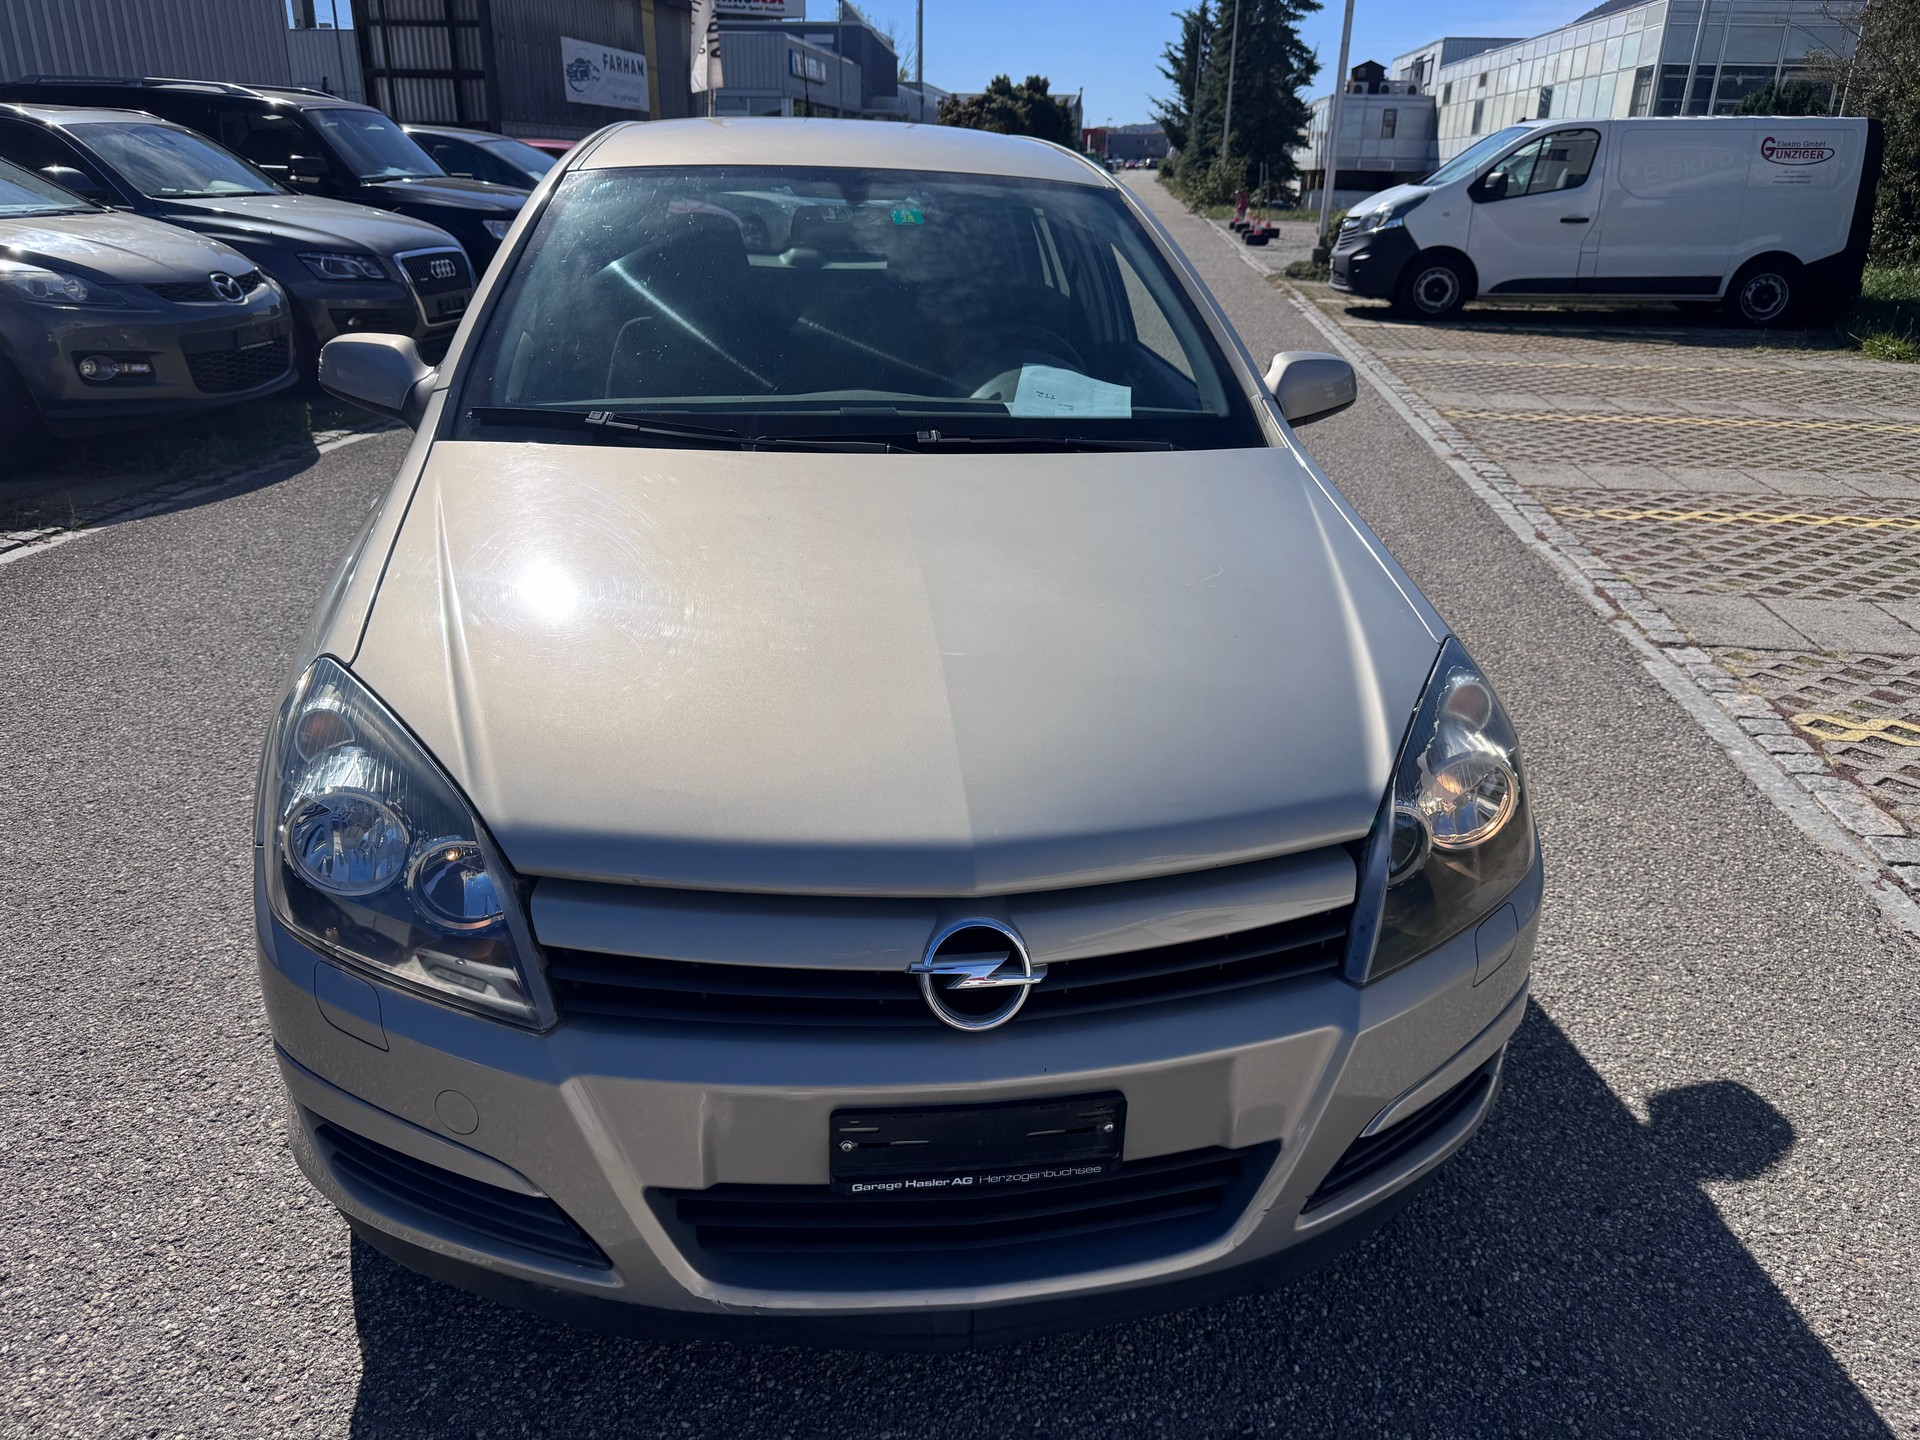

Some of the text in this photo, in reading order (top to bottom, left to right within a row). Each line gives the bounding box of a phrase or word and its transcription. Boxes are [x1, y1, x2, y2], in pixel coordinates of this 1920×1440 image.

[602, 53, 644, 77] FARHAN
[852, 1166, 1102, 1192] Garage Hasler AG Herzogenbuchsee
